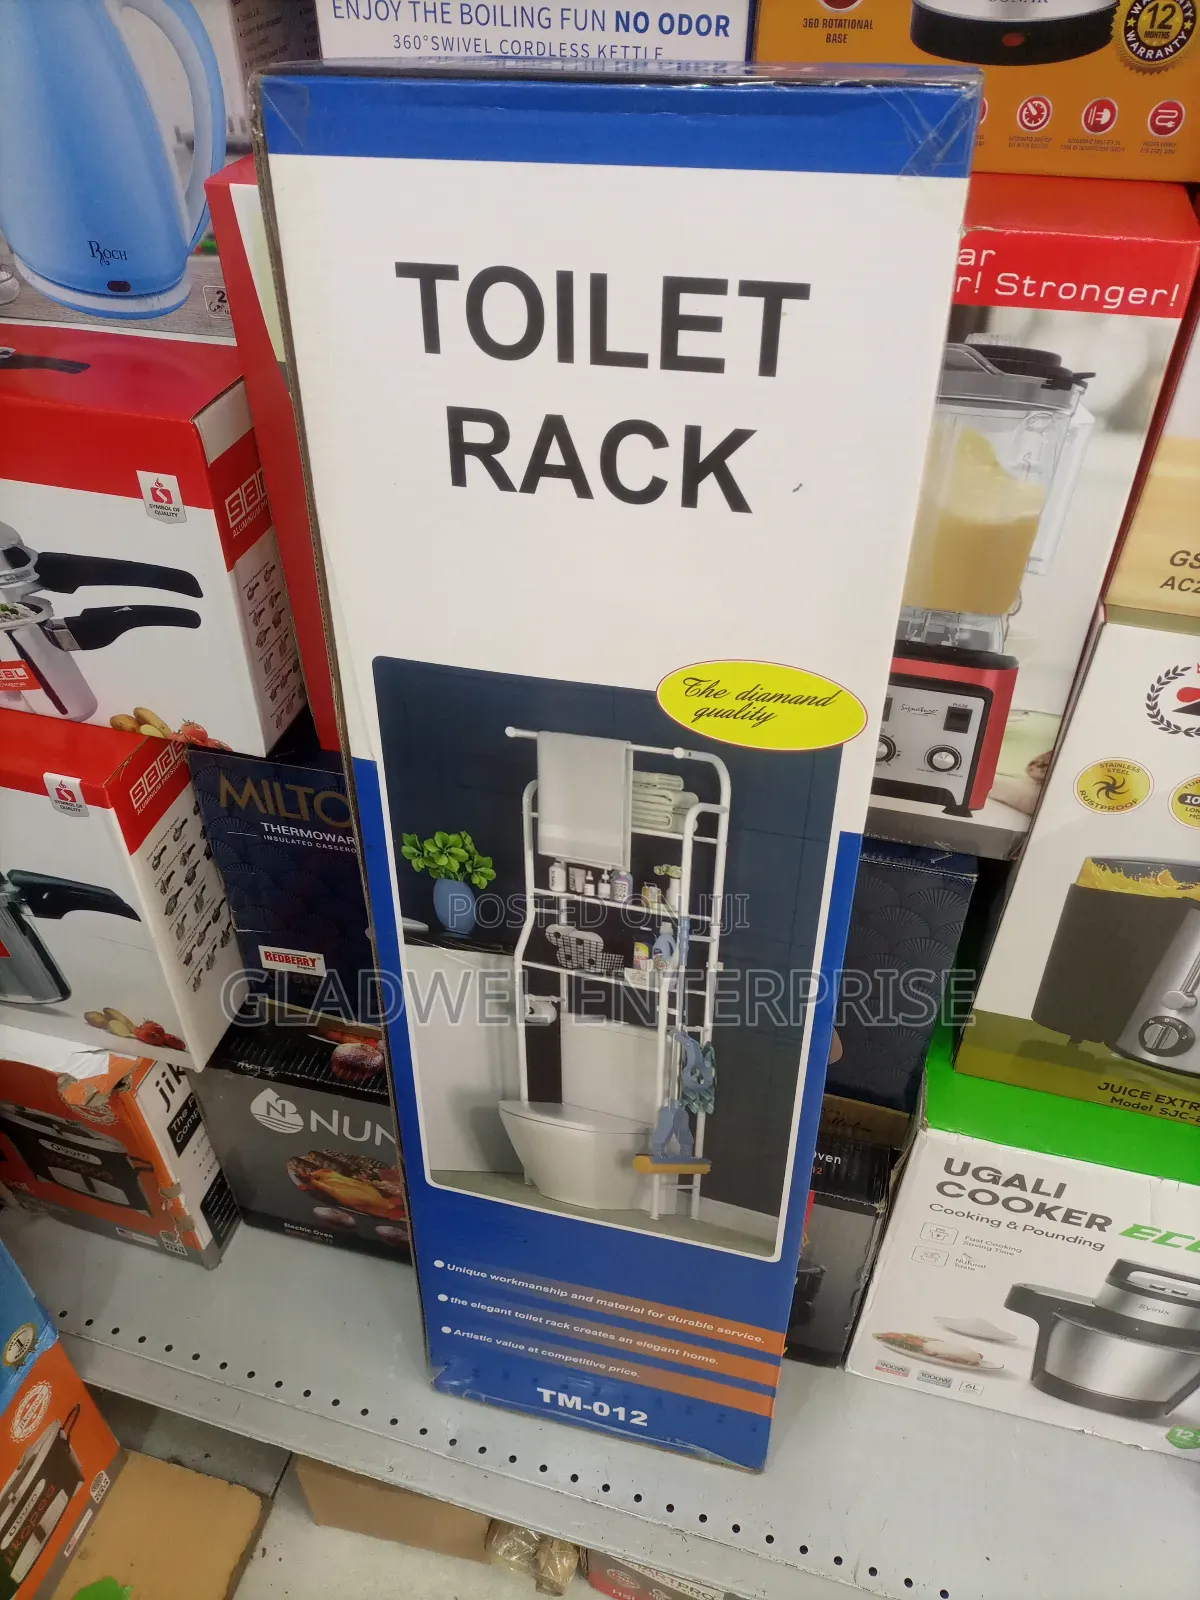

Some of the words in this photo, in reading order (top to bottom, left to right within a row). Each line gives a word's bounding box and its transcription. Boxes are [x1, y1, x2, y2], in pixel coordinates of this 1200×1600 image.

[332, 0, 400, 21] ENJOY
[408, 1, 452, 24] THE
[460, 3, 552, 29] BOILING
[560, 8, 606, 31] FUN
[615, 11, 650, 34] NO
[658, 13, 731, 37] ODOR
[803, 18, 819, 28] 360
[822, 18, 873, 30] ROTATIONAL
[1147, 3, 1177, 30] 12
[826, 33, 848, 43] BASE
[1126, 30, 1187, 59] WARRANTY
[500, 40, 590, 58] CORDLESS
[598, 45, 664, 60] KETTLE
[958, 248, 996, 267] ar
[216, 290, 228, 303] 2
[956, 271, 982, 294] r!
[994, 272, 1180, 309] Stronger!
[394, 261, 811, 378] TOILET
[446, 405, 758, 514] RACK
[149, 503, 172, 512] SYMBOL
[682, 677, 732, 699] The
[735, 684, 843, 707] diamand
[691, 702, 778, 728] quality
[900, 703, 938, 715] Signature
[1099, 762, 1140, 774] STAINLESS
[1106, 768, 1130, 776] STEEL
[220, 770, 353, 828] MILTO
[1079, 789, 1139, 811] RUSTPROOF
[260, 821, 356, 846] THERMOWAR
[263, 834, 313, 847] INSULATED
[264, 950, 317, 968] REDBERRY
[1097, 1082, 1151, 1100] JUICE
[1110, 1096, 1154, 1112] Model
[171, 1108, 188, 1132] The
[310, 1109, 397, 1146] NUN
[943, 1157, 1067, 1199] UGALI
[936, 1181, 1113, 1233] COOKER
[929, 1203, 1002, 1229] Cooking
[1006, 1220, 1018, 1231] &
[1022, 1224, 1106, 1252] Pounding
[962, 1241, 993, 1252] Saving
[994, 1248, 1015, 1256] Time
[965, 1236, 983, 1244] Fast
[985, 1240, 1023, 1253] Cooking
[954, 1263, 976, 1271] Taste
[447, 1263, 488, 1278] Unique
[489, 1273, 568, 1298] workmanship
[570, 1293, 594, 1303] and
[596, 1297, 645, 1314] material
[647, 1309, 666, 1319] for
[667, 1314, 714, 1331] durable
[716, 1326, 765, 1344] service.
[1138, 1303, 1170, 1316] Syinix
[450, 1297, 468, 1306] the
[470, 1301, 512, 1316] elegant
[514, 1311, 544, 1324] toilet
[545, 1319, 571, 1330] rack
[573, 1325, 616, 1340] creates
[618, 1336, 633, 1344] an
[636, 1340, 680, 1356] elegant
[682, 1350, 719, 1365] home.
[453, 1329, 493, 1343] Artistic
[495, 1338, 525, 1351] value
[527, 1345, 539, 1354] at
[541, 1348, 606, 1369] competitive
[608, 1365, 640, 1378] price.
[880, 1362, 906, 1372] 900W
[920, 1372, 951, 1384] 1000W
[965, 1383, 979, 1391] 6L
[536, 1386, 649, 1427] TM-012
